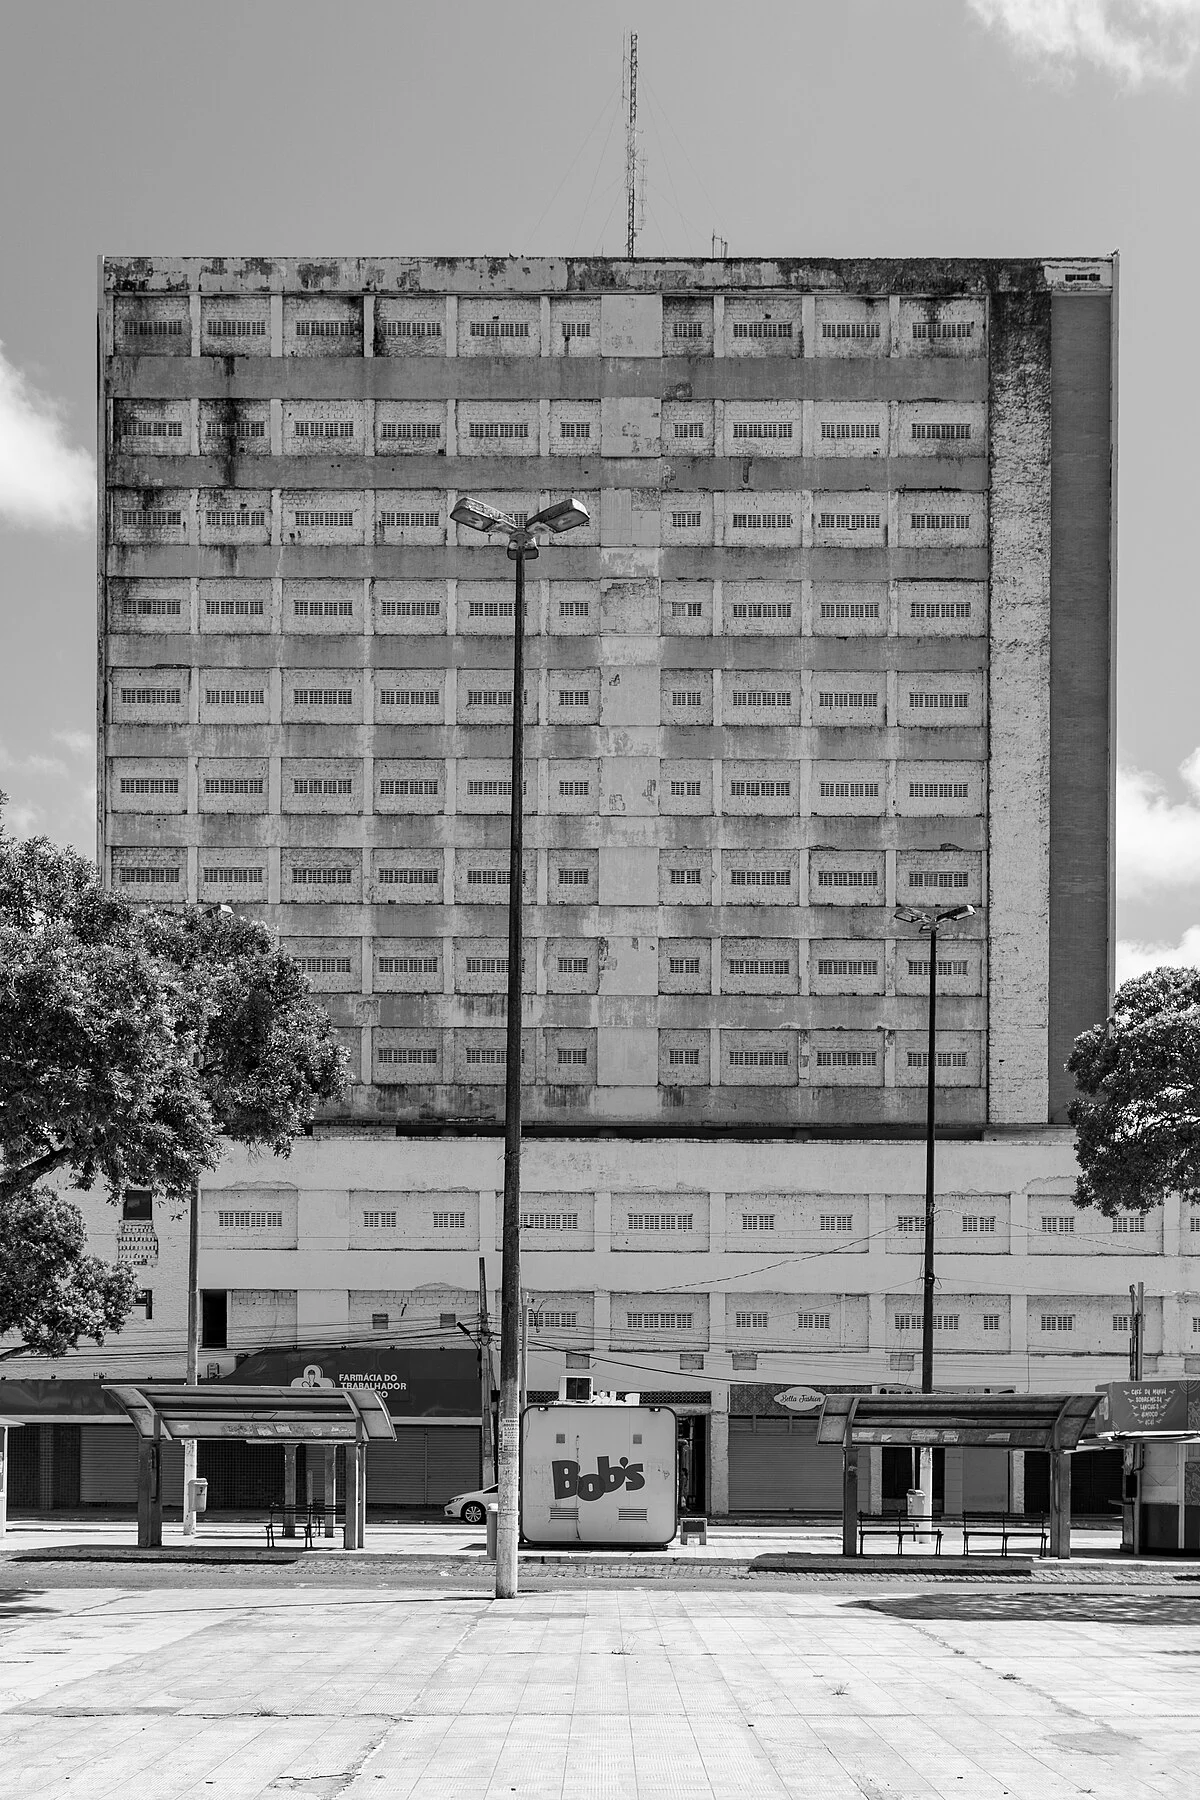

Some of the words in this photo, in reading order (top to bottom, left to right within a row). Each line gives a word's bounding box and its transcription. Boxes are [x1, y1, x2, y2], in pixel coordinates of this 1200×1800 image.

[339, 1373, 382, 1381] FARMÁCIA
[340, 1382, 407, 1390] TRABALHADOR
[552, 1455, 646, 1502] Bob's
